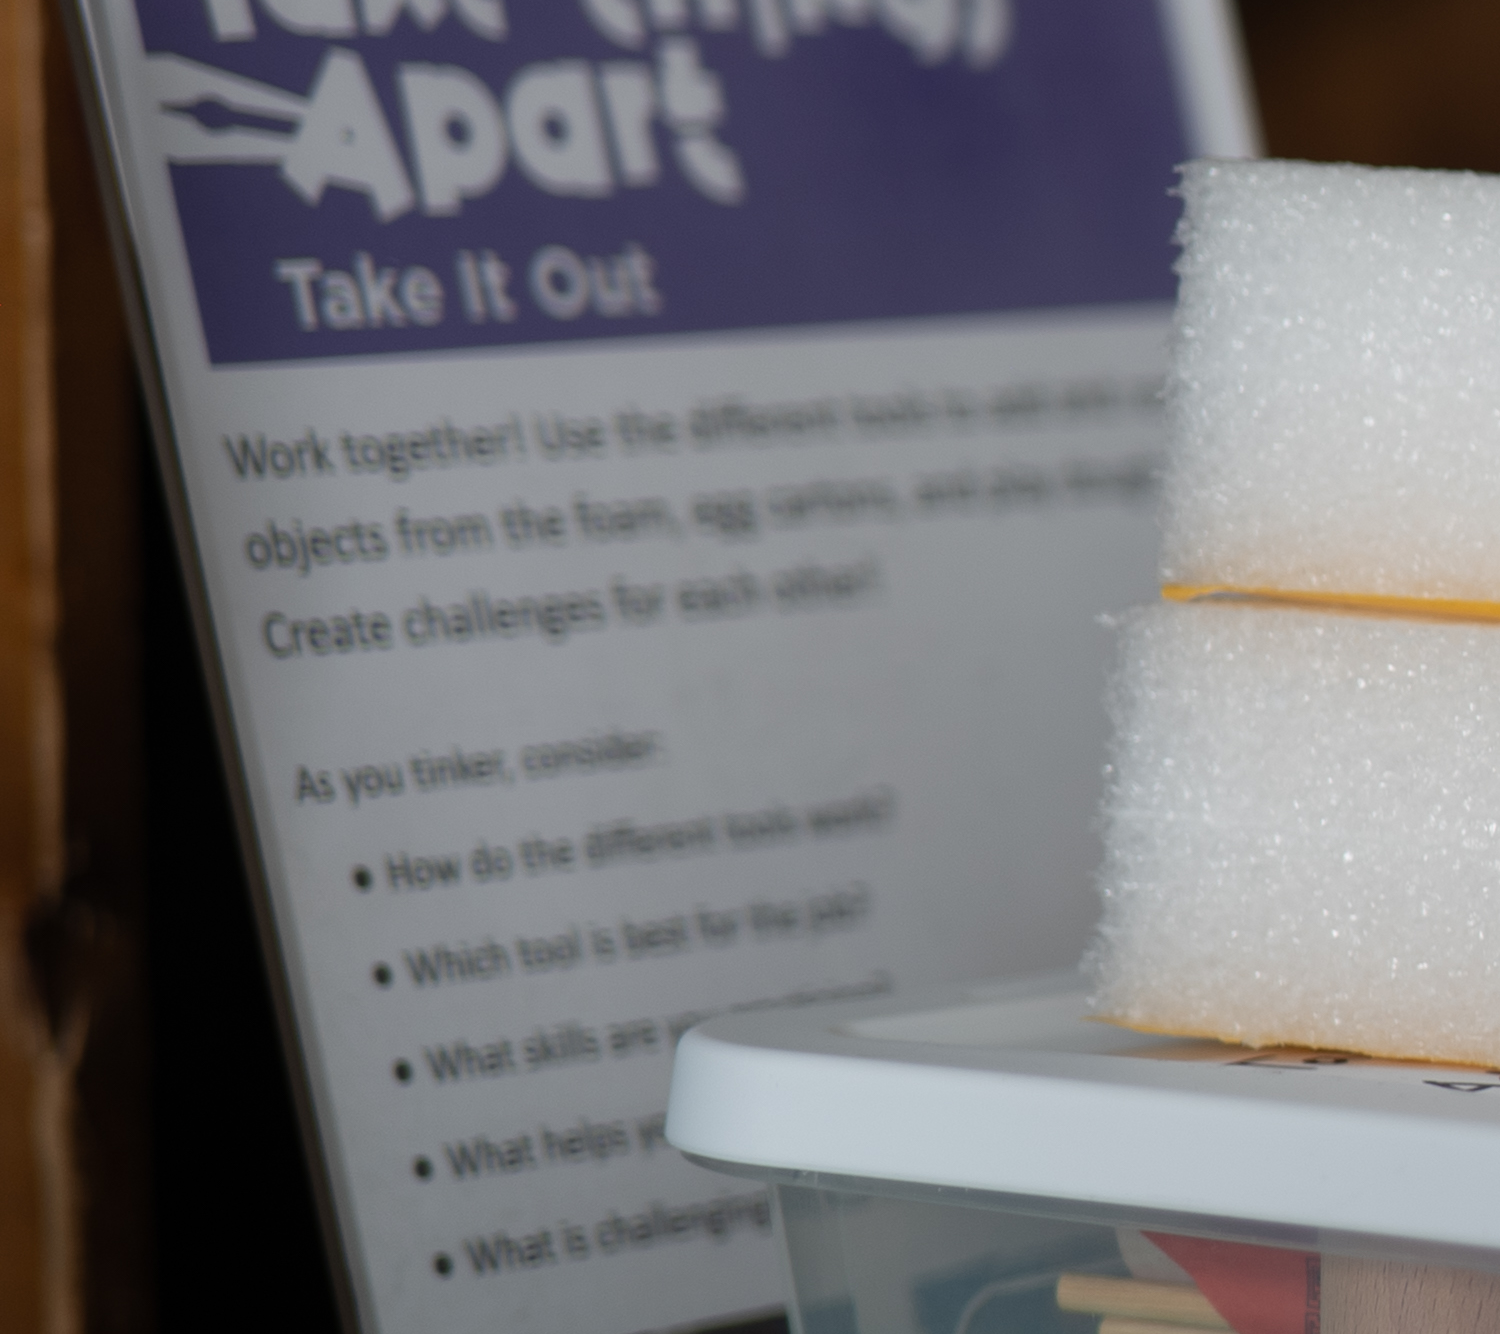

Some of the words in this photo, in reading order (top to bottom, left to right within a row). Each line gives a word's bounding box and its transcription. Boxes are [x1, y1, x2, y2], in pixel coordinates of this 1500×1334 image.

[280, 42, 746, 221] Apart
[277, 257, 443, 332] Take
[531, 242, 662, 319] Out
[222, 425, 334, 481] Work
[340, 412, 528, 483] together!
[537, 411, 606, 461] Use
[619, 406, 675, 450] the
[690, 393, 838, 447] different
[244, 516, 389, 574] objects
[397, 507, 495, 561] from
[502, 499, 565, 548] the
[261, 608, 394, 661] Create
[403, 586, 604, 647] challenges
[614, 575, 669, 624] for
[678, 567, 760, 619] each
[295, 765, 336, 805] As
[342, 758, 405, 808] you
[409, 742, 516, 793] tinker,
[385, 848, 461, 894] How
[472, 838, 514, 882] do
[520, 828, 577, 872] the
[585, 813, 715, 866] different
[405, 941, 507, 992] Which
[520, 927, 582, 975] tool
[593, 924, 616, 963] is
[626, 911, 691, 958] best
[423, 1040, 513, 1086] What
[524, 1020, 601, 1066] skills
[609, 1025, 660, 1054] are
[442, 1135, 534, 1182] What
[541, 1118, 631, 1164] helps
[463, 1232, 554, 1278] What
[564, 1222, 591, 1259] is
